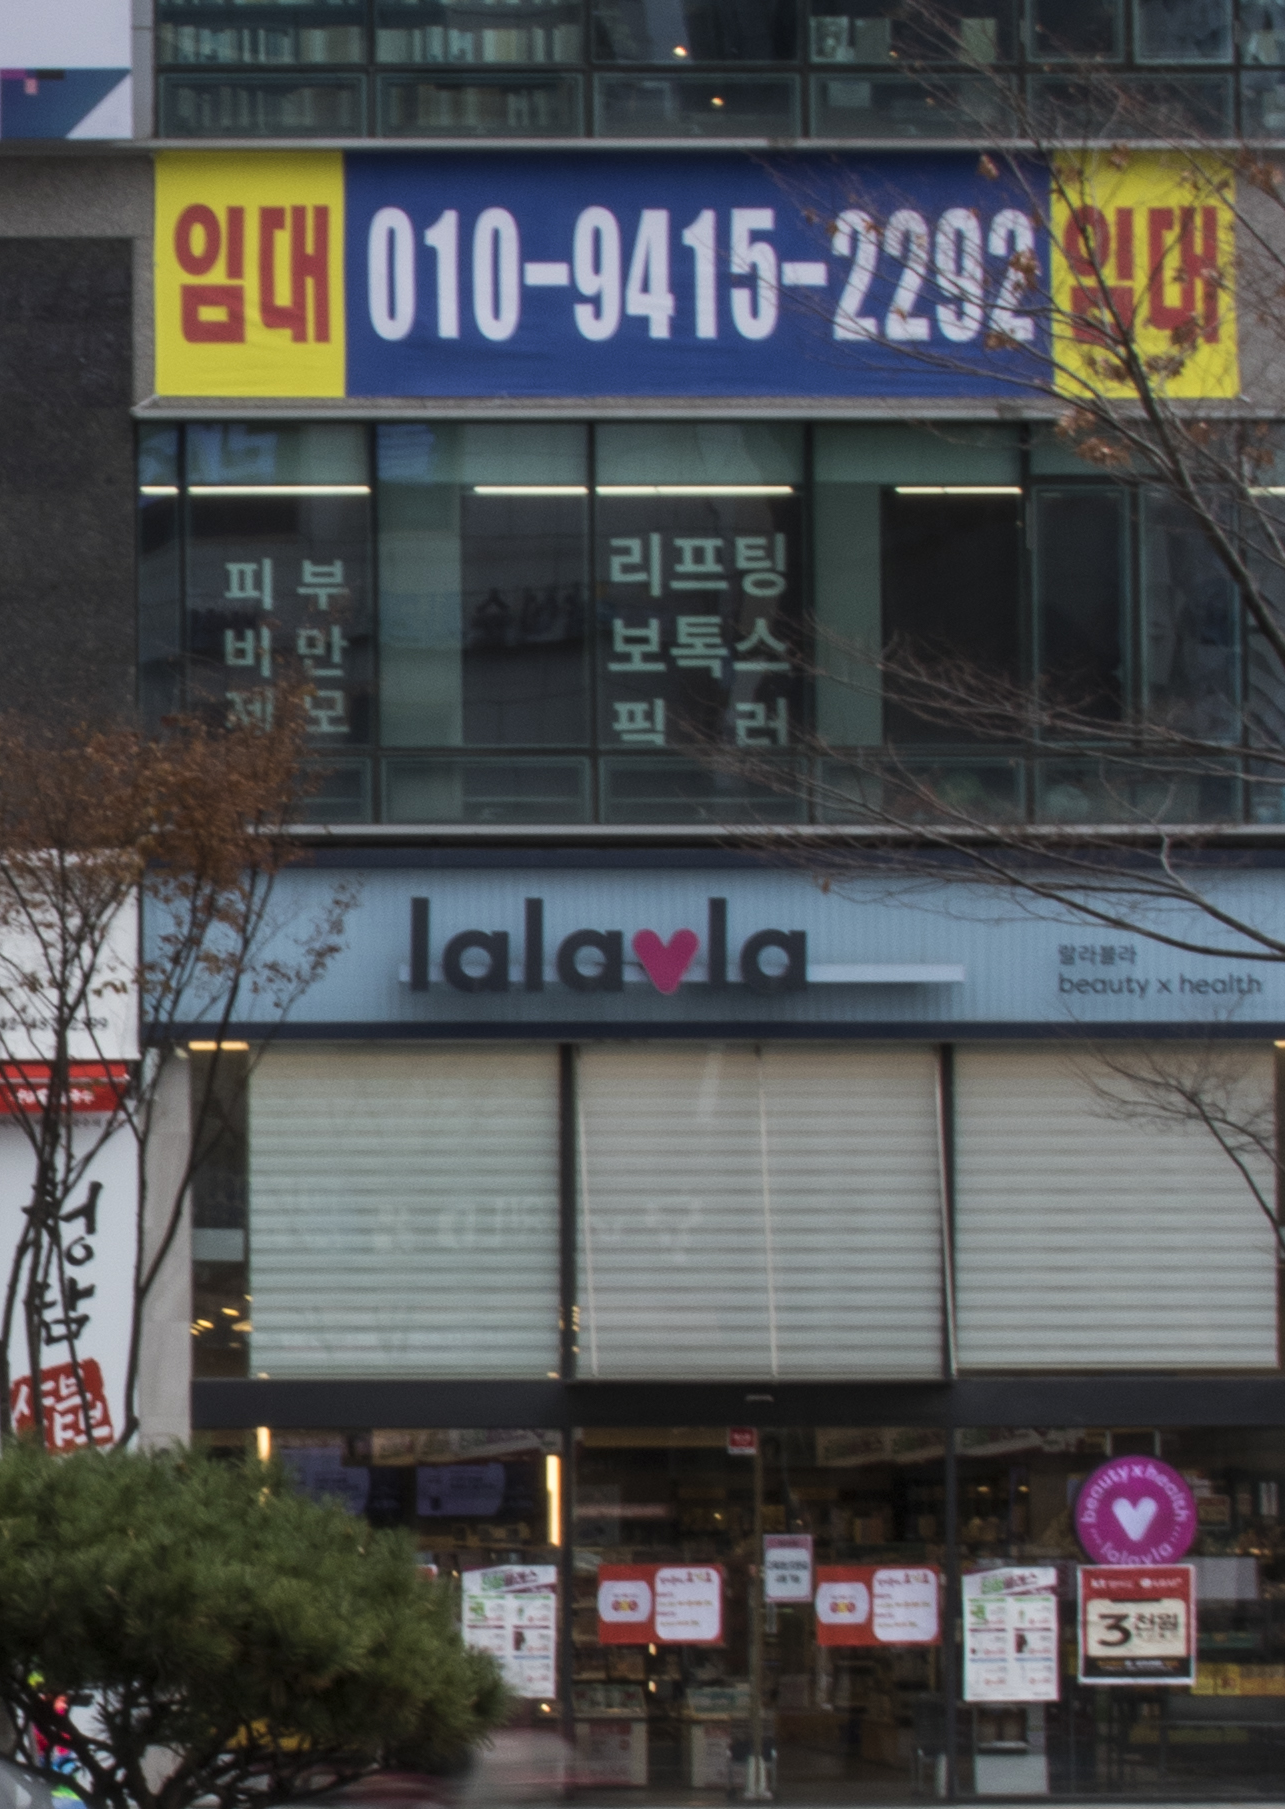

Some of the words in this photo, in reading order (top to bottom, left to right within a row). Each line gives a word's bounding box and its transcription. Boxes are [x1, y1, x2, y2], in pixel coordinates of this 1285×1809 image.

[173, 202, 331, 344] 임대
[367, 204, 1035, 342] 010-9415-2292
[224, 558, 349, 611] 피부
[610, 532, 787, 598] 리프팅
[224, 625, 349, 678] 비만
[607, 615, 791, 679] 보톡스
[1058, 945, 1137, 965] 랄라블라
[1058, 973, 1149, 999] beauty
[1157, 978, 1172, 994] x
[1180, 973, 1263, 995] health
[1081, 1466, 1129, 1523] beauty
[1145, 1464, 1188, 1522] health
[1099, 1613, 1132, 1647] 3
